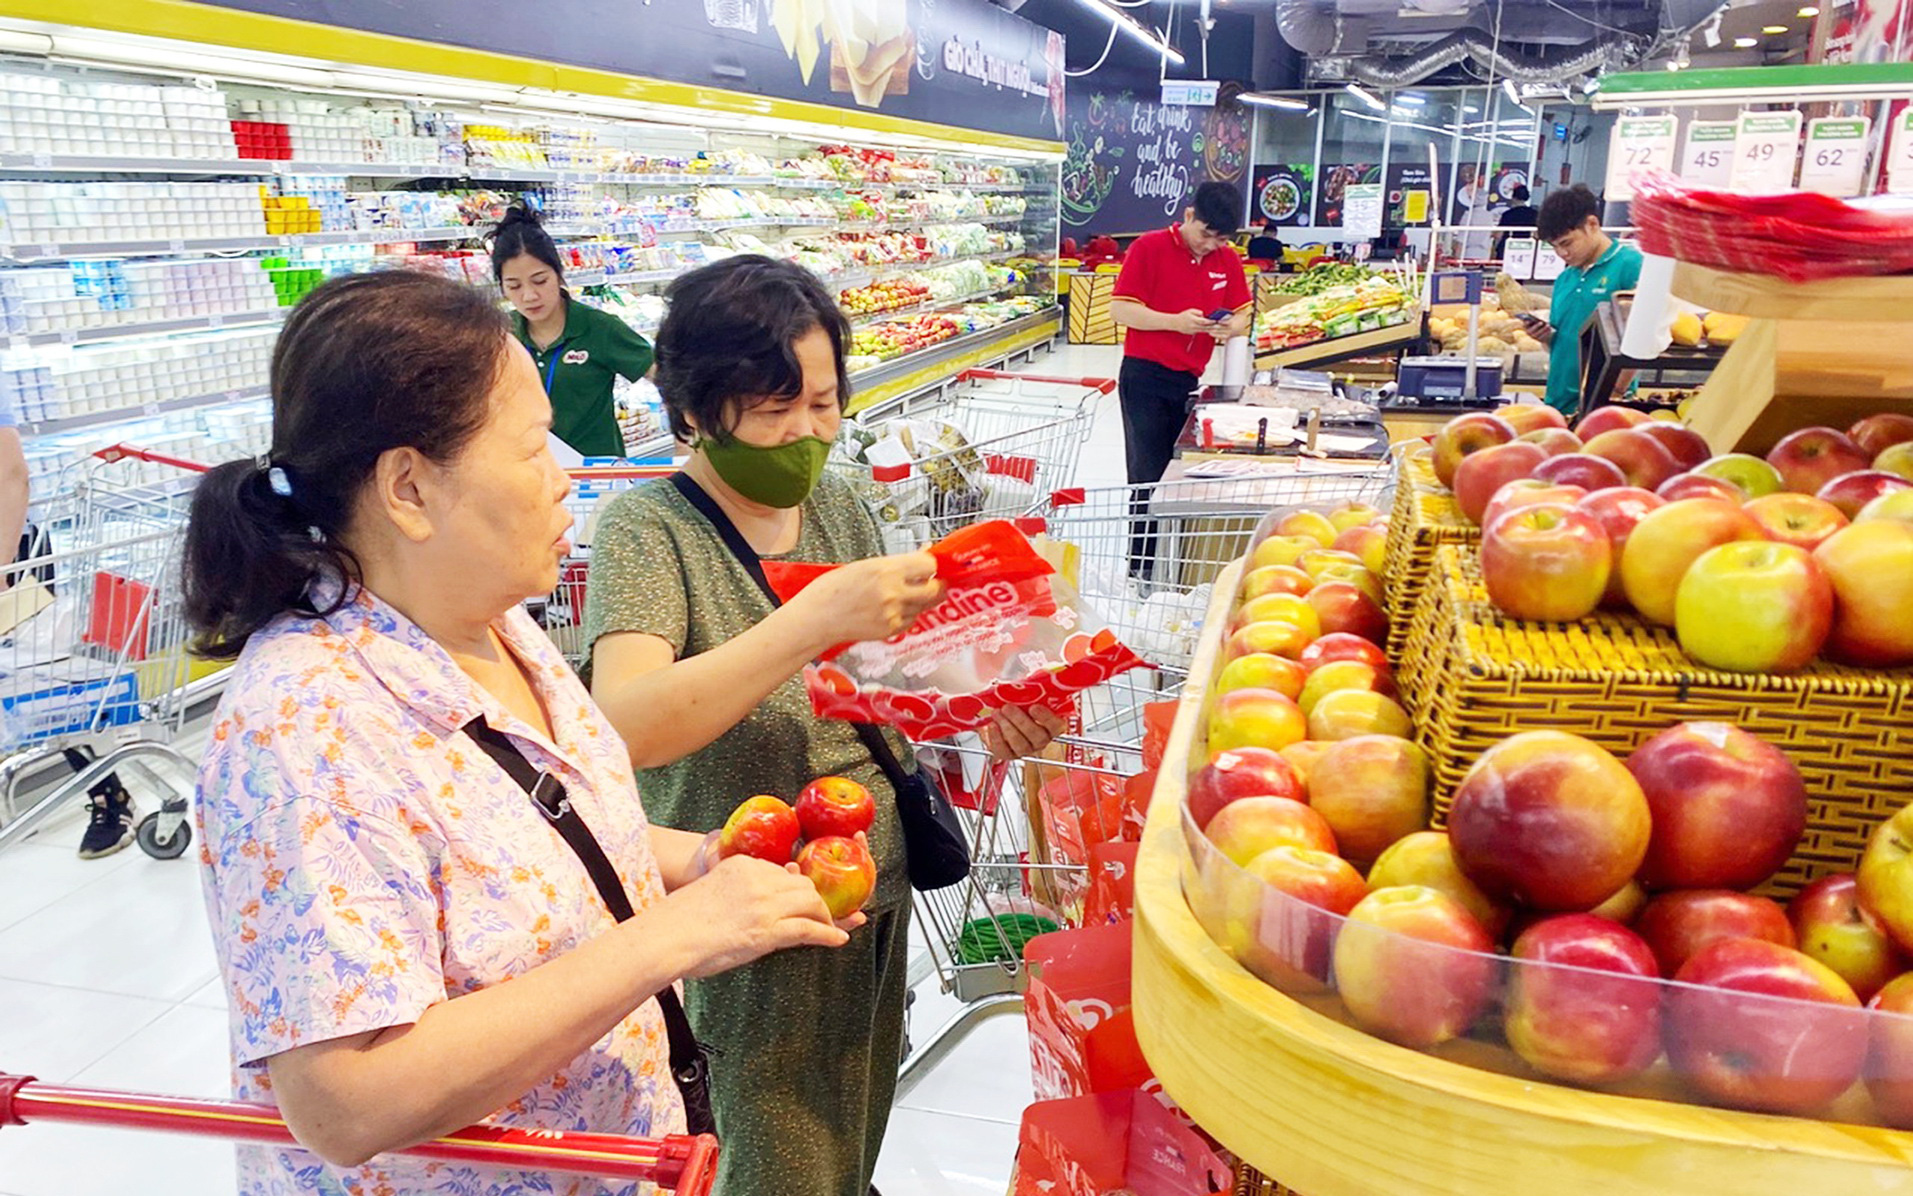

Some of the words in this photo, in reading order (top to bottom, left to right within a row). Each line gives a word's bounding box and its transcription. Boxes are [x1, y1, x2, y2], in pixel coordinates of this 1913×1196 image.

[1131, 101, 1156, 135] Eat,
[1157, 104, 1192, 133] drink
[1137, 135, 1163, 166] and
[1163, 131, 1181, 160] be
[1625, 147, 1651, 166] 72
[1746, 143, 1774, 161] 49
[1816, 149, 1843, 166] 62
[1694, 150, 1720, 168] 45
[1130, 163, 1188, 216] healthy
[1510, 254, 1524, 263] 14
[1542, 254, 1556, 264] 79
